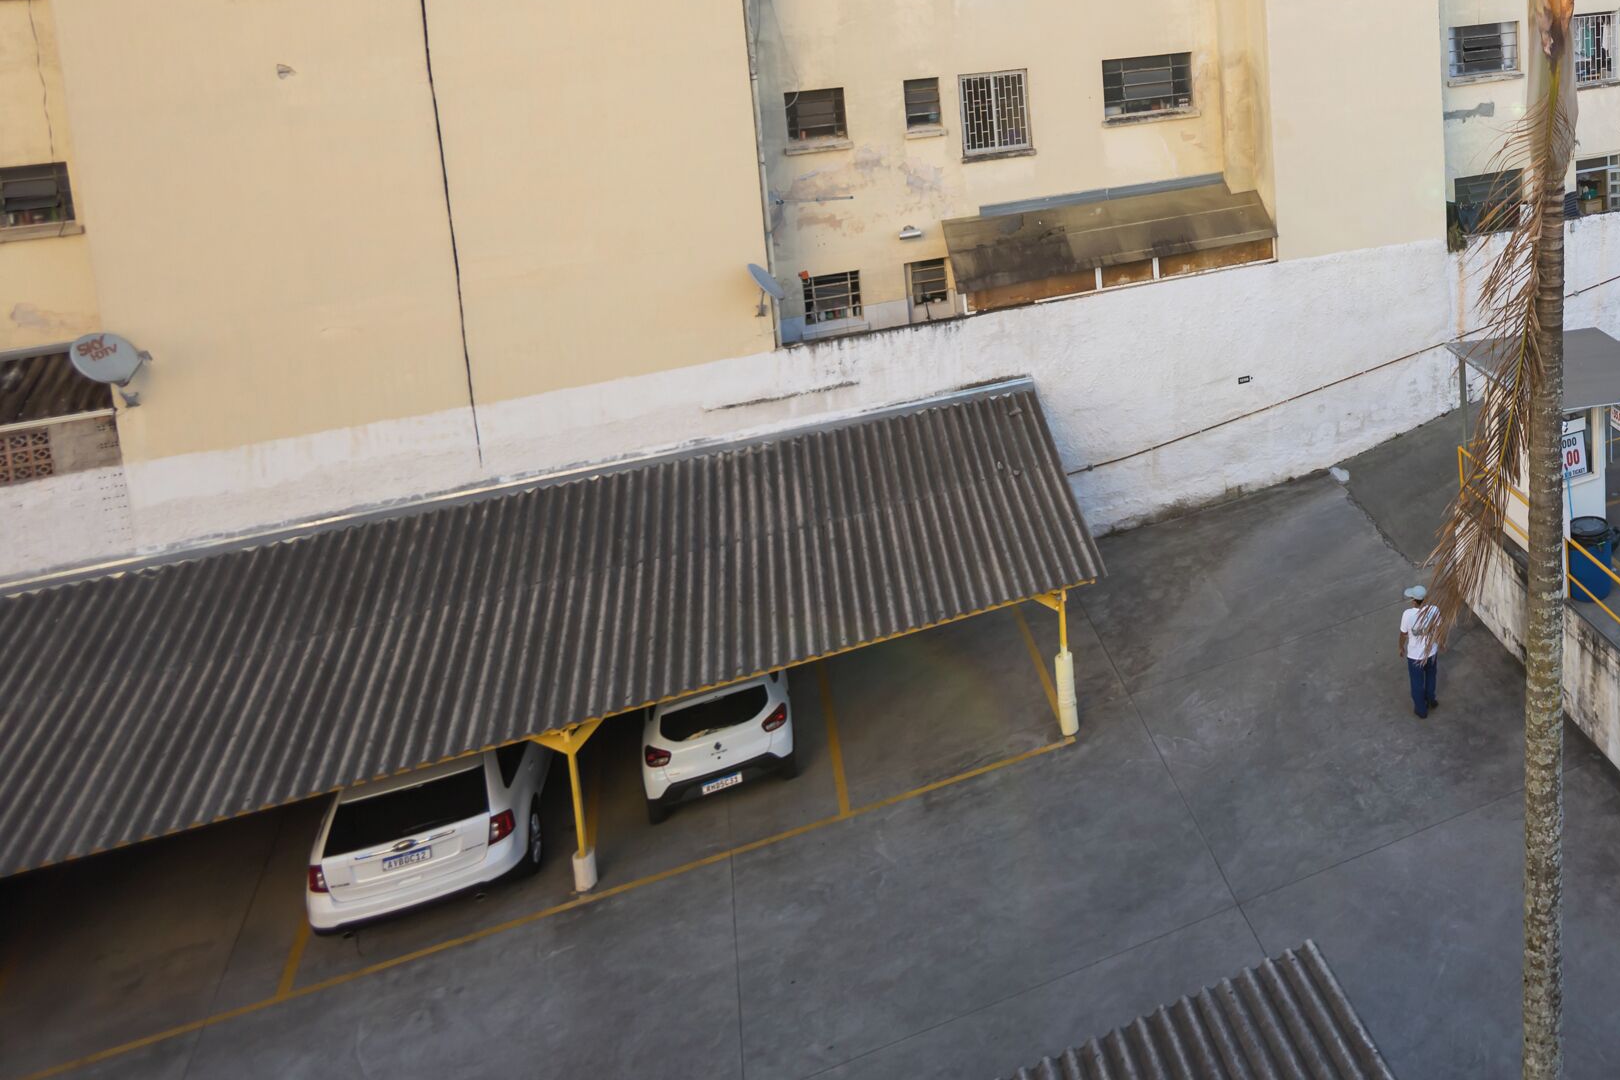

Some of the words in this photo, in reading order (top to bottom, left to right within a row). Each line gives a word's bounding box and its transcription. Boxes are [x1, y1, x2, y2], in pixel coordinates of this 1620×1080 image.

[77, 333, 104, 356] SKY
[90, 344, 117, 361] HDTV
[1561, 437, 1577, 449] ODO
[1564, 449, 1580, 469] ,00
